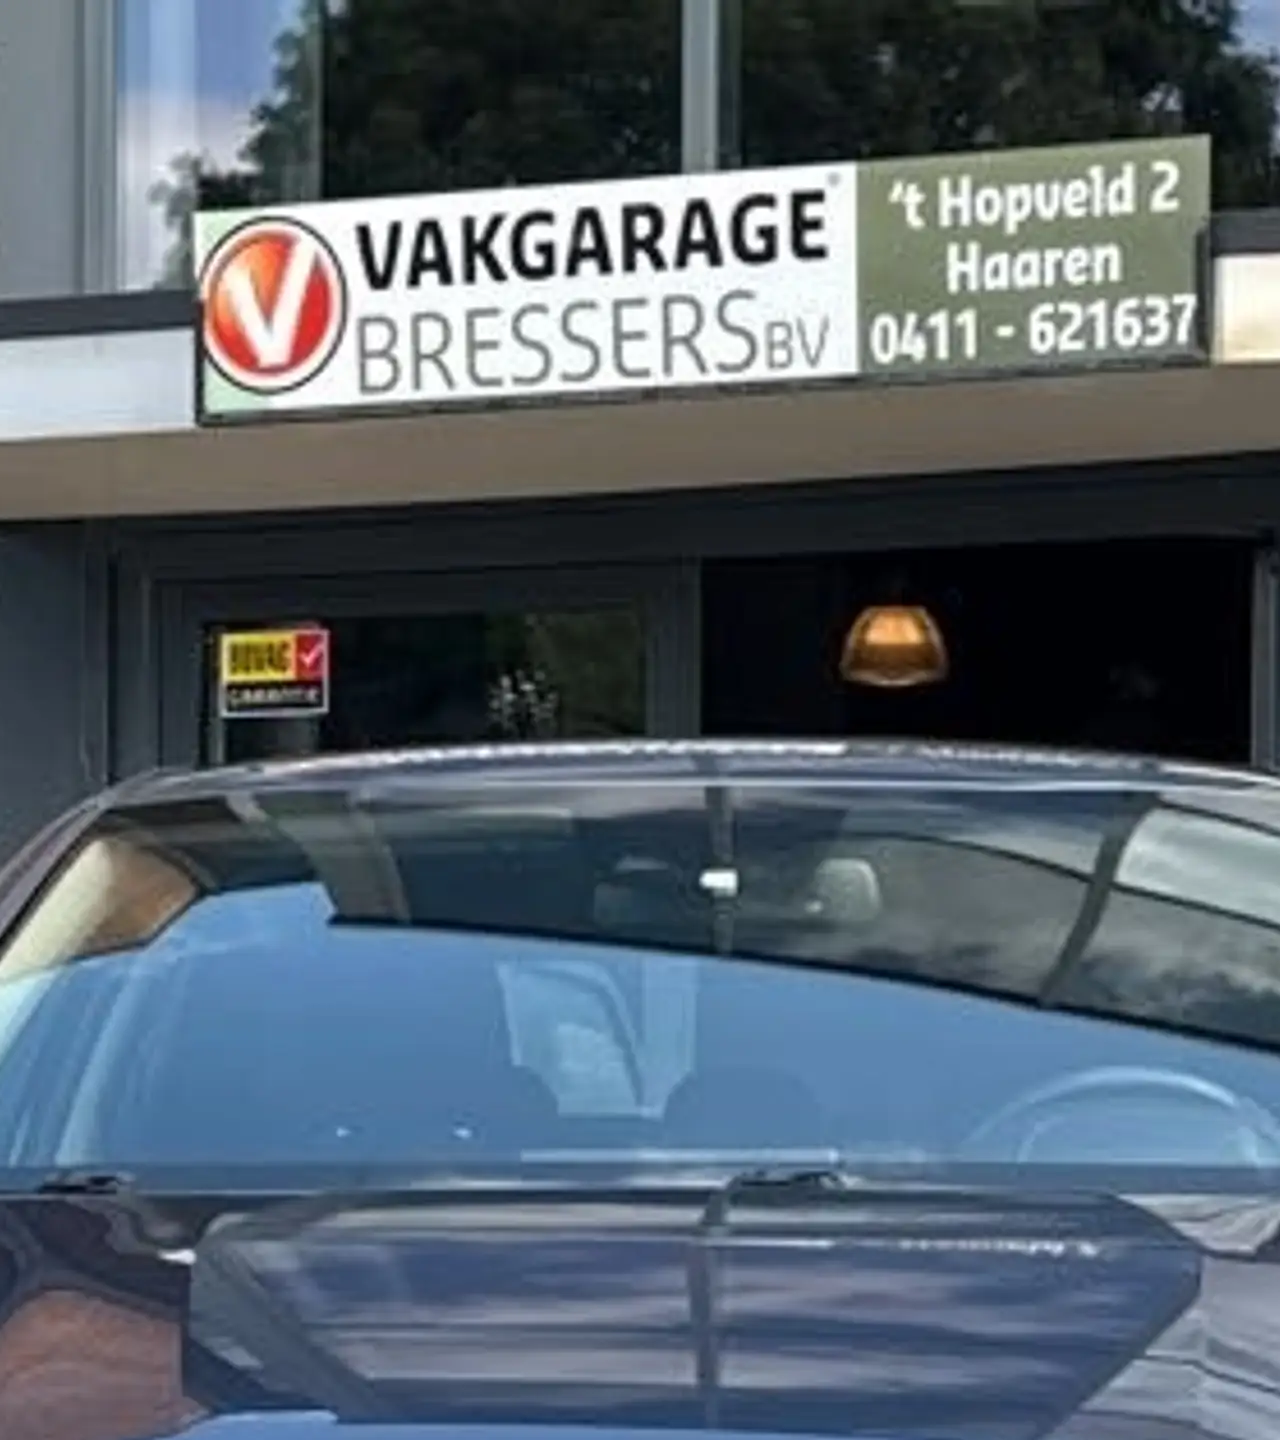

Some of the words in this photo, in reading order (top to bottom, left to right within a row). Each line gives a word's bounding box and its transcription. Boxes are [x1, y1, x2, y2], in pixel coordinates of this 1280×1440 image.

[937, 162, 1137, 236] Hopveld
[1150, 160, 1180, 213] 2
[355, 189, 830, 290] VAKGARAGE
[946, 240, 1122, 295] Haaren
[870, 308, 978, 366] 0411
[1028, 292, 1198, 354] 621637
